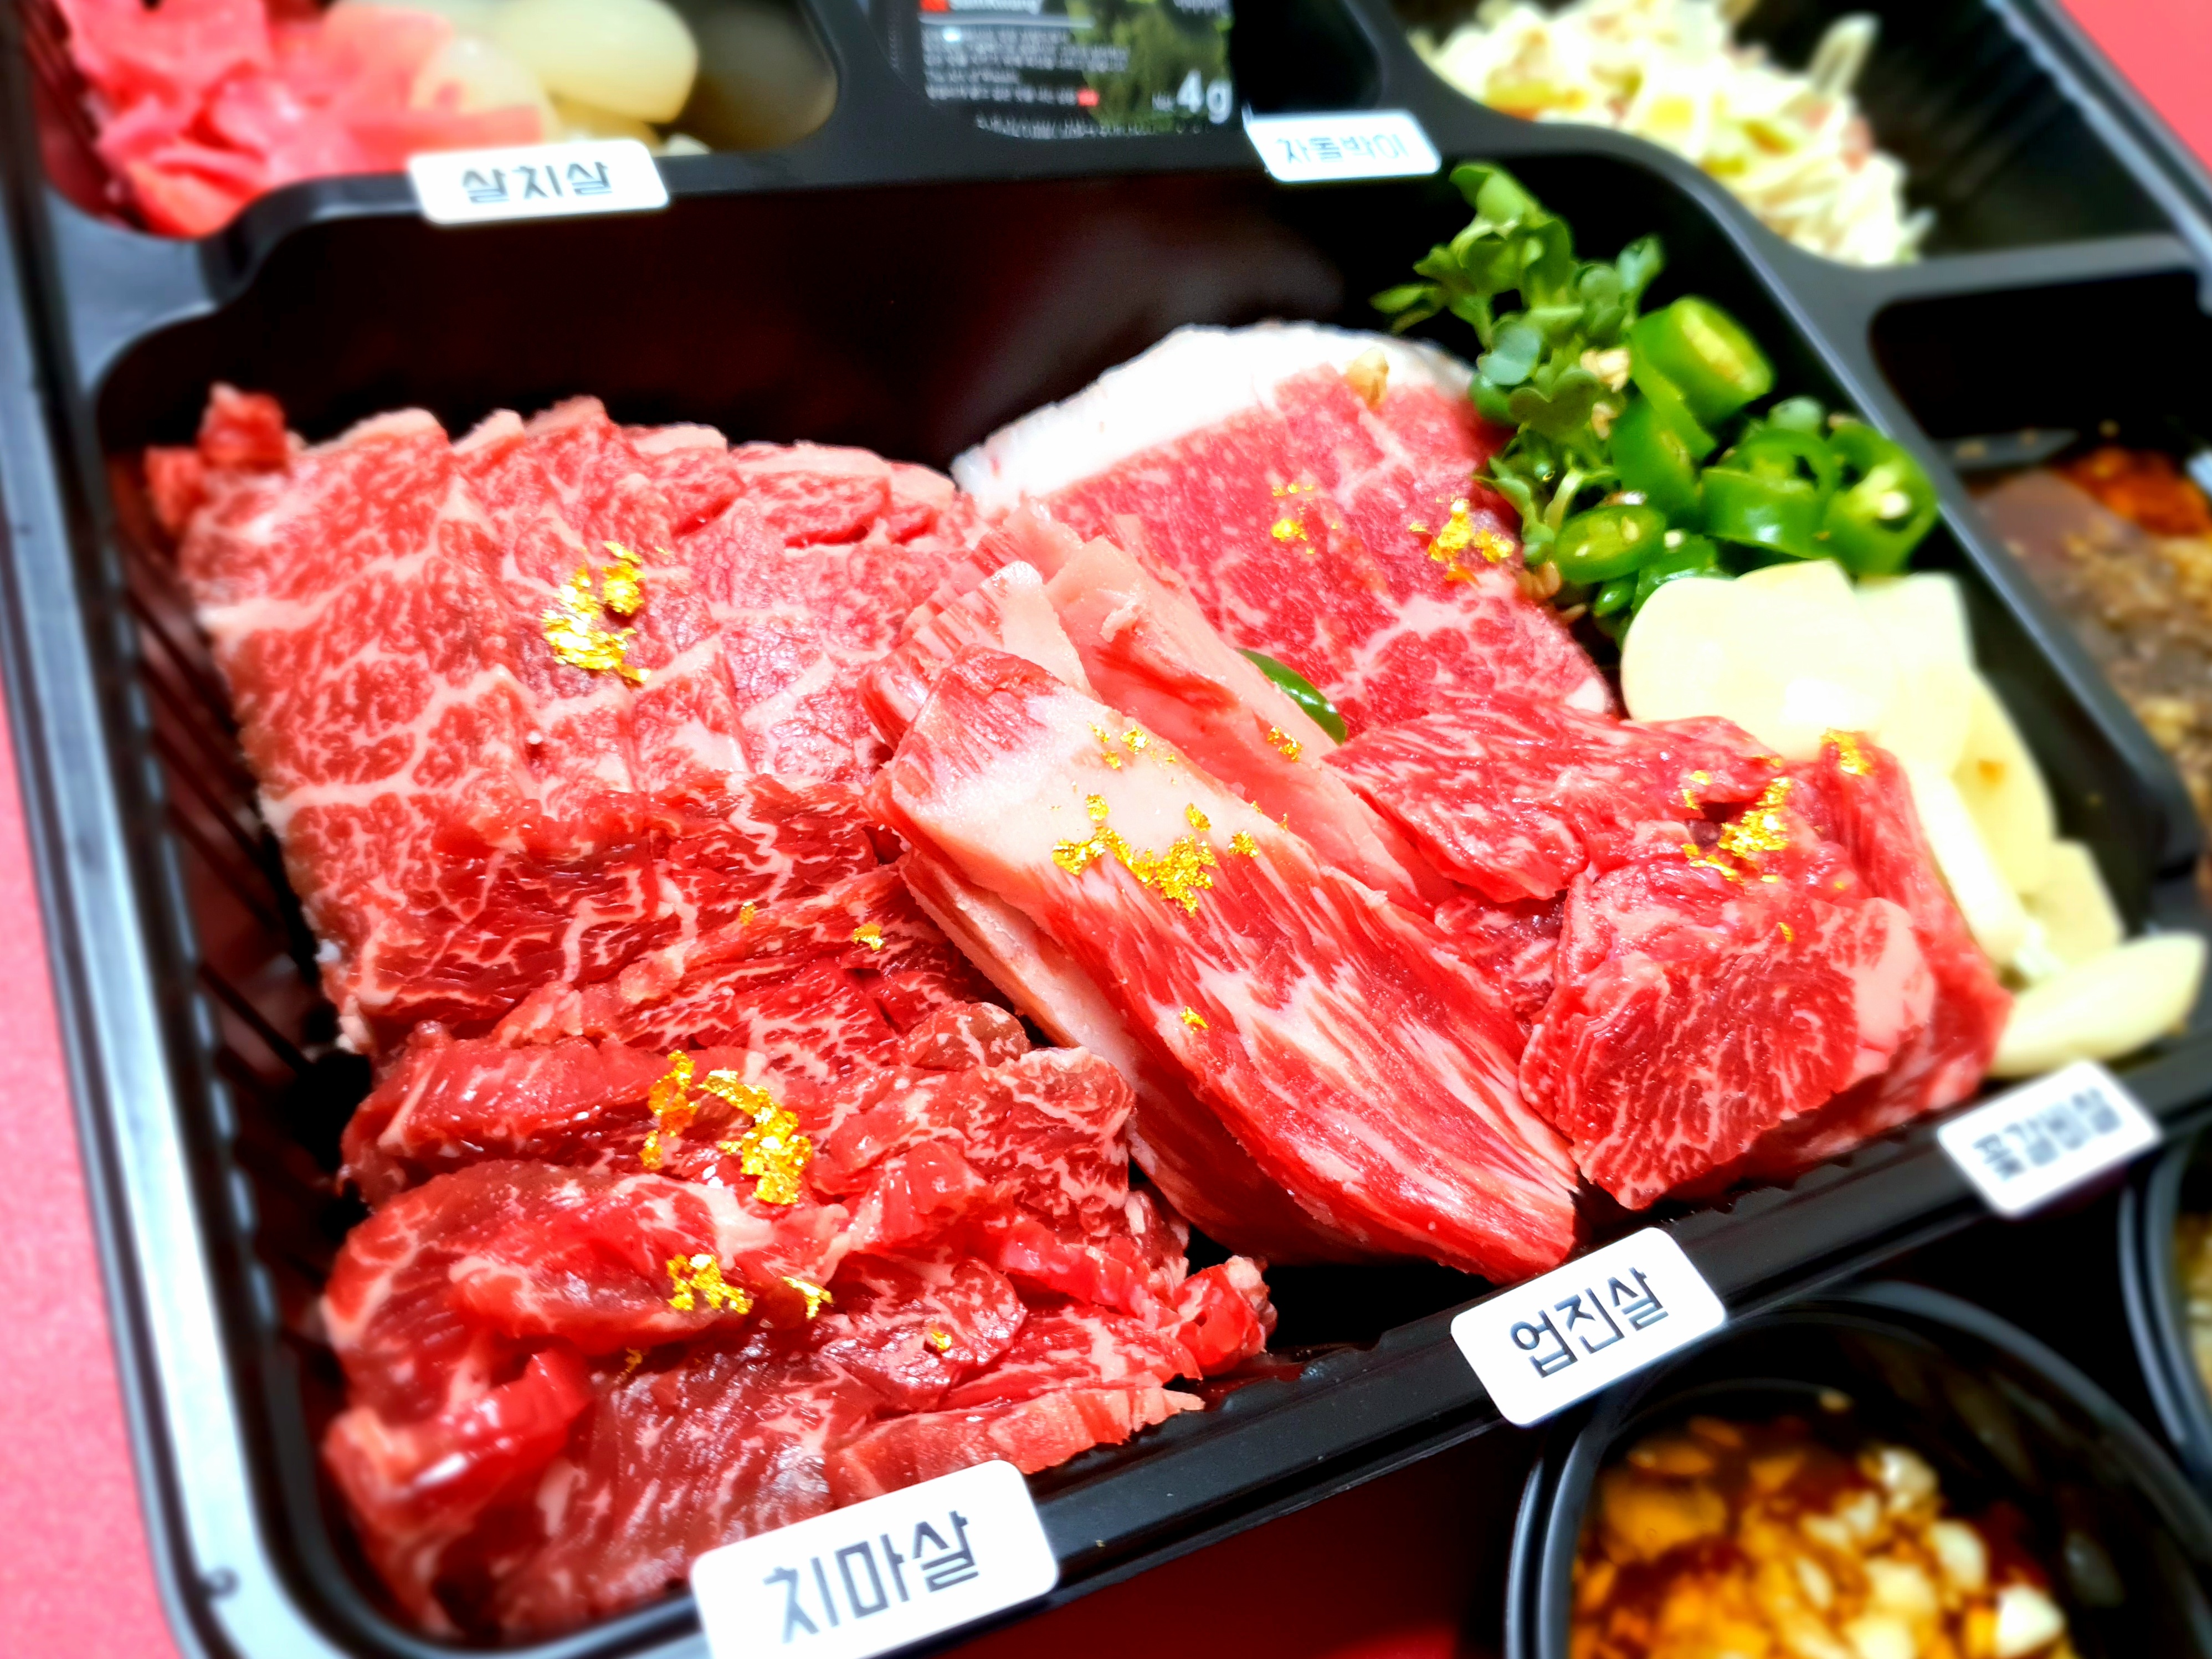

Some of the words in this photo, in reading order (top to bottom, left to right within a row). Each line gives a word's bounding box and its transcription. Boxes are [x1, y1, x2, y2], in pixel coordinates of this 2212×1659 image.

[462, 162, 612, 204] 살치살
[1509, 1266, 1670, 1379] 업진살
[762, 1511, 980, 1644] 치마살
